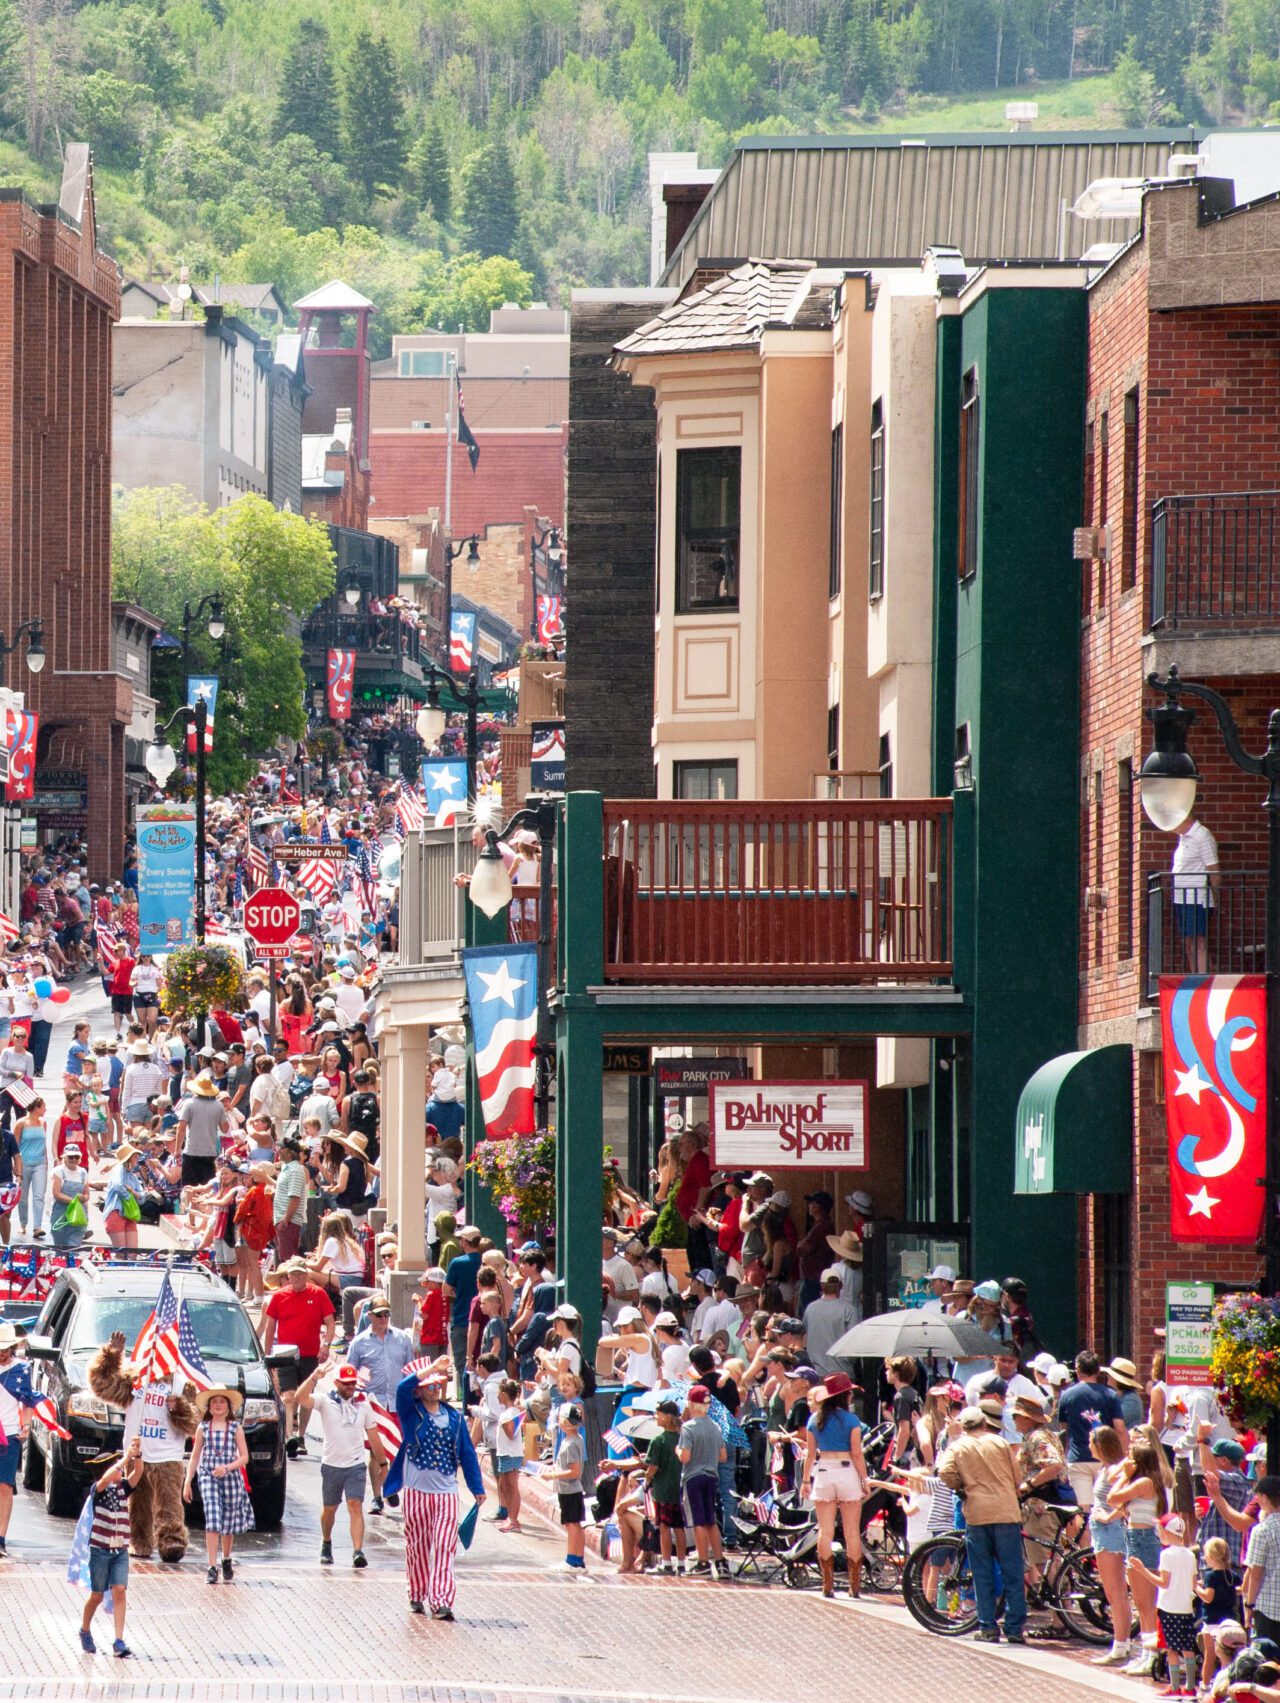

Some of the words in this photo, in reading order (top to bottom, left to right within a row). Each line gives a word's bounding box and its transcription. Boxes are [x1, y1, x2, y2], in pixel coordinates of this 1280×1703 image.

[293, 848, 321, 857] Heber
[324, 848, 345, 857] Ave.
[146, 868, 164, 877] Every
[167, 867, 191, 877] Sunday
[247, 905, 297, 928] STOP
[258, 948, 271, 956] ALL
[273, 948, 287, 956] WAY
[683, 1071, 708, 1081] PARK
[709, 1071, 731, 1081] CITY
[144, 1392, 165, 1407] RED
[138, 1425, 168, 1440] BLUE
